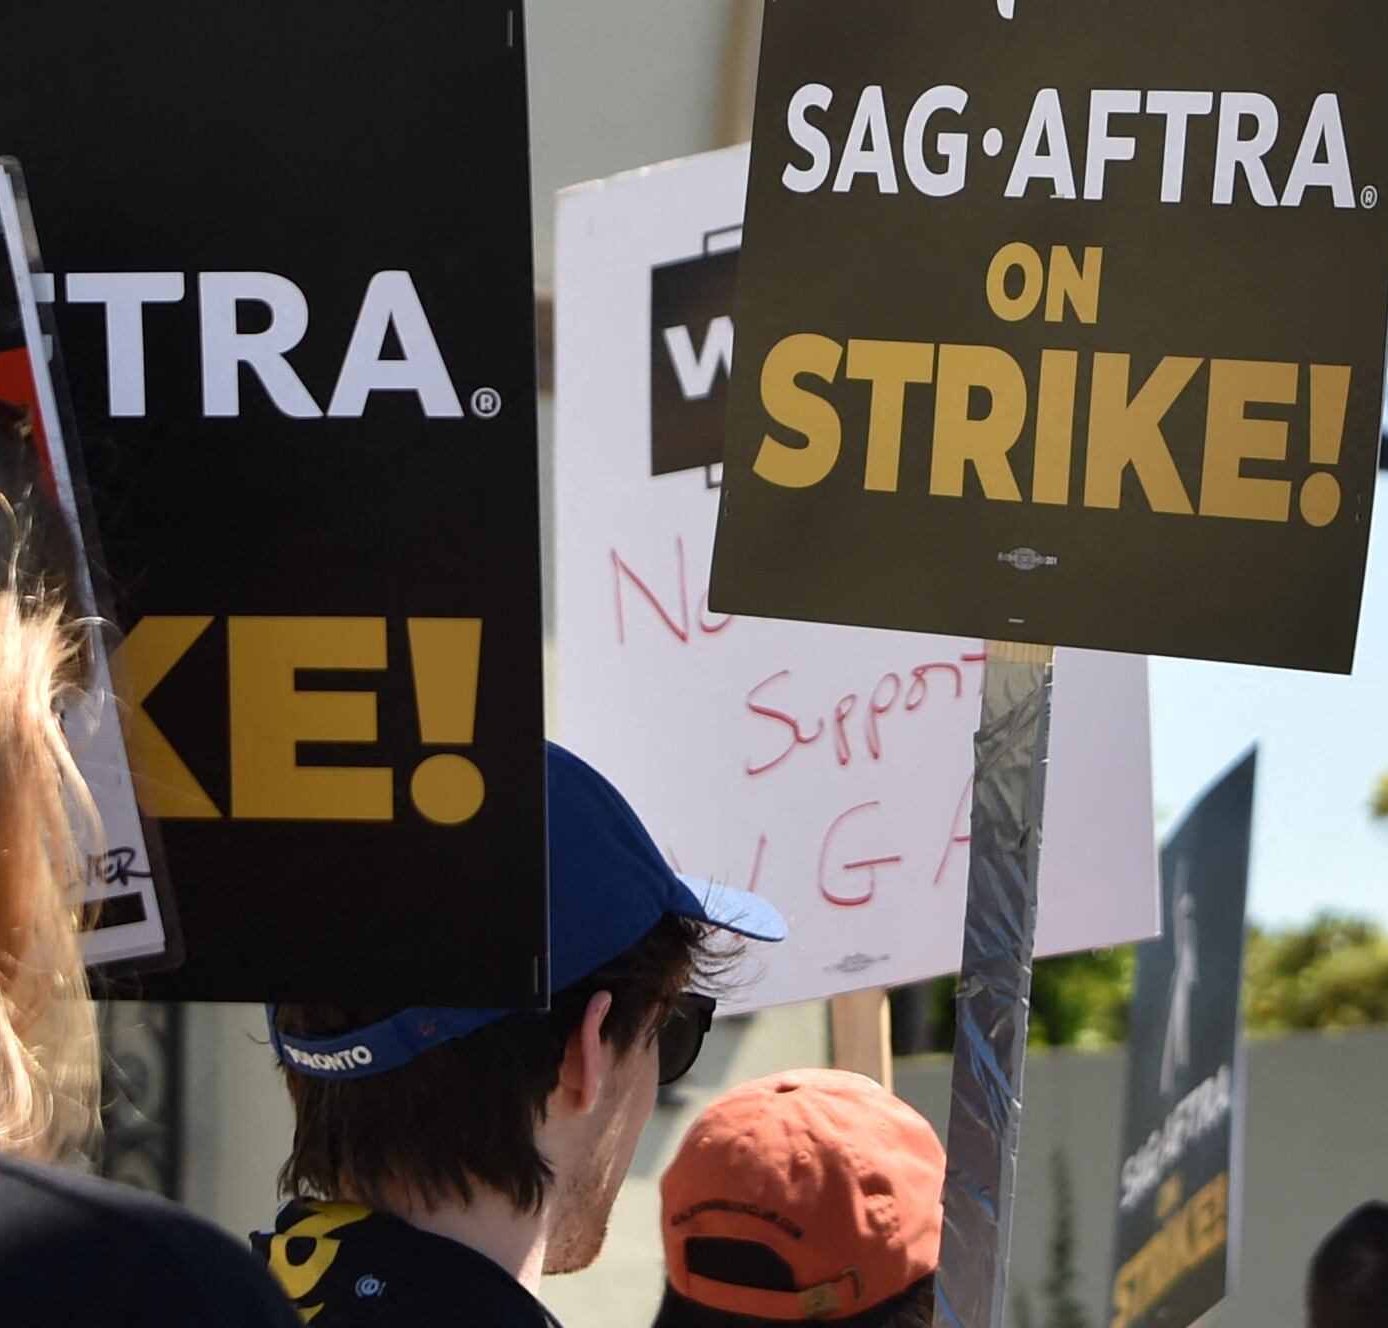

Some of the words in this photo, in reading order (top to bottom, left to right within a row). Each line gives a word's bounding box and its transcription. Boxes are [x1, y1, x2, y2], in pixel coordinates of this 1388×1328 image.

[985, 241, 1103, 324] ON
[752, 332, 1353, 527] STRIKE!
[284, 1045, 373, 1071] TORONTO
